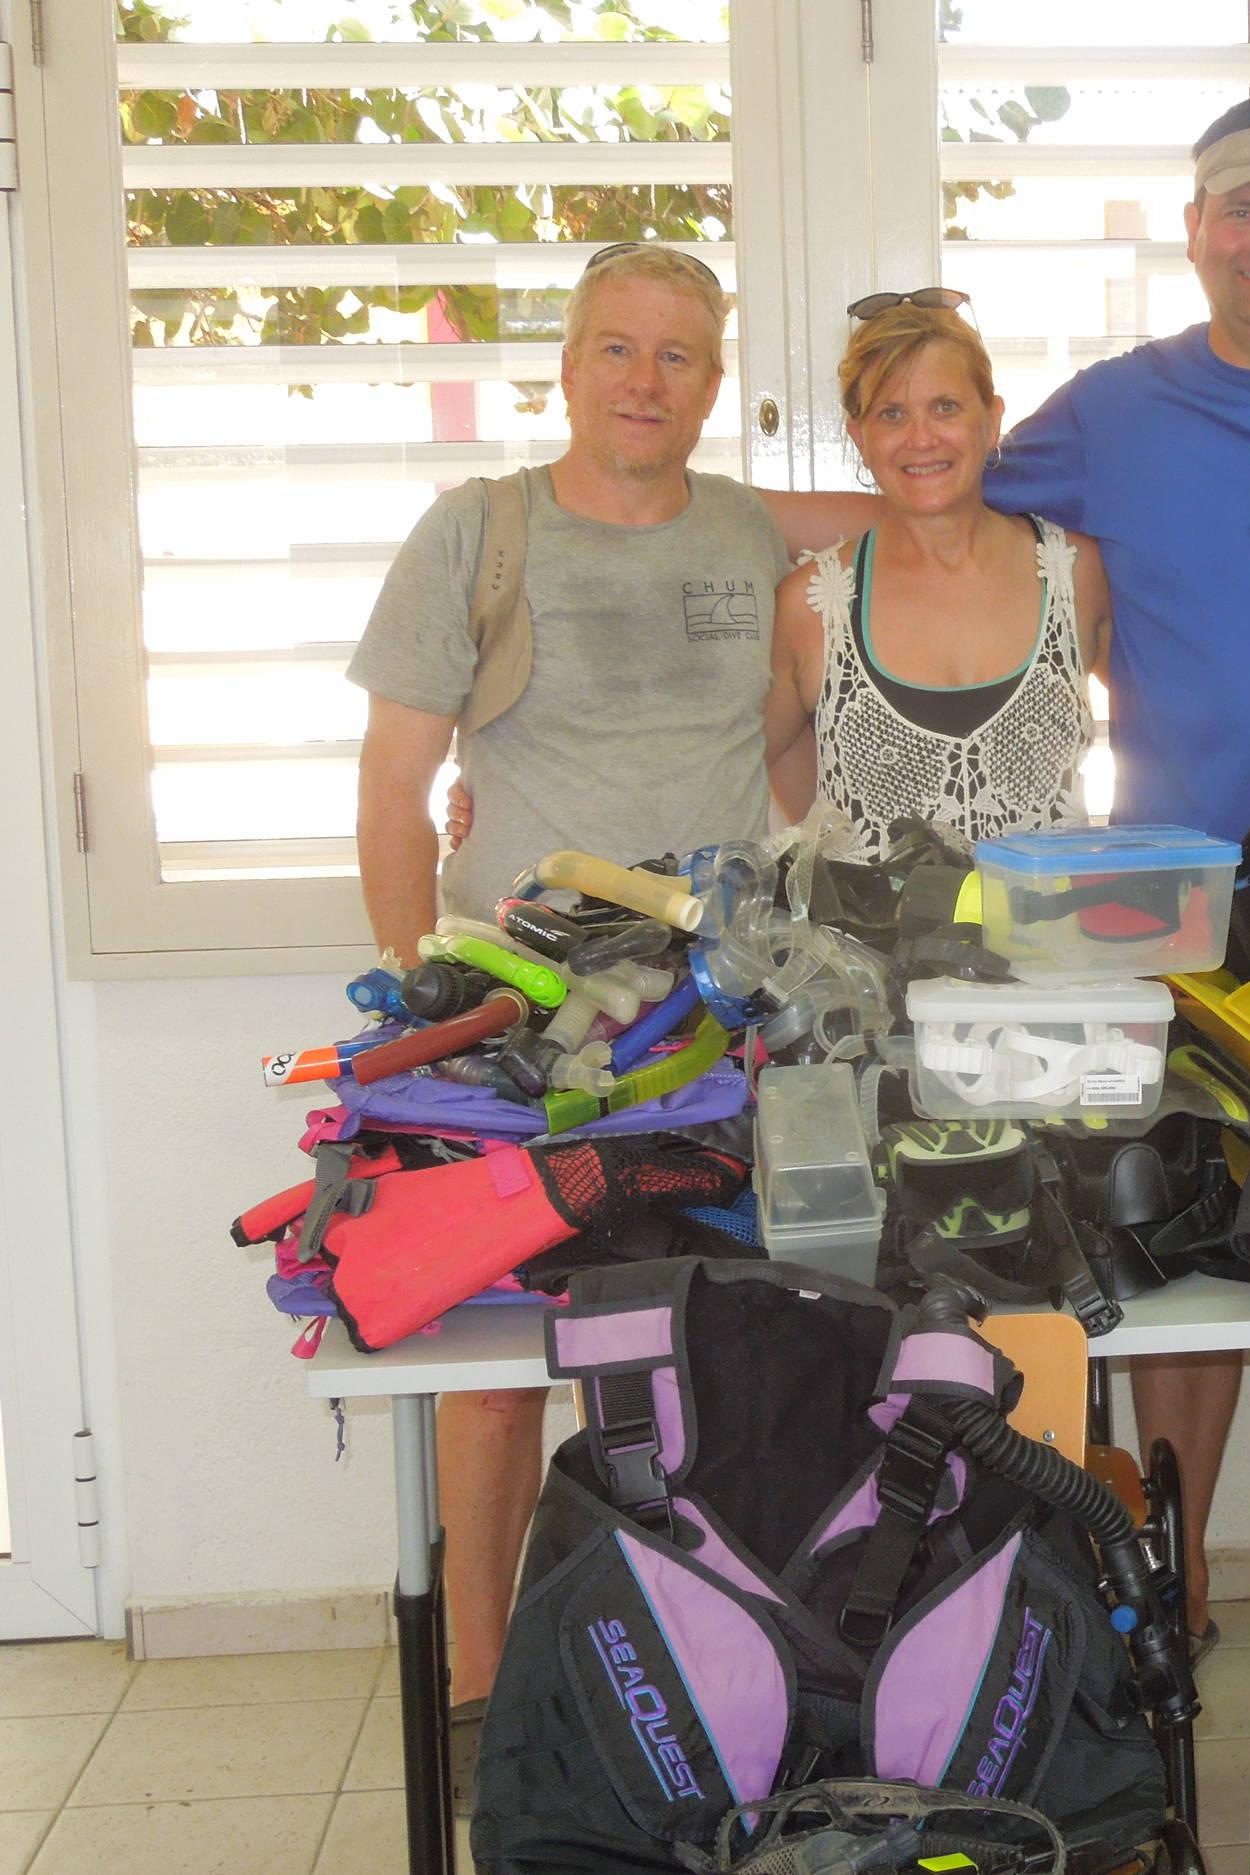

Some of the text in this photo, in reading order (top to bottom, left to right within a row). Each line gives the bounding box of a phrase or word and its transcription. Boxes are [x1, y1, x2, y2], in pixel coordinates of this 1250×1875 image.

[682, 580, 755, 594] CHUM
[687, 632, 718, 643] SOCIAL
[723, 631, 742, 640] DIVE
[507, 912, 558, 942] ATOMIC
